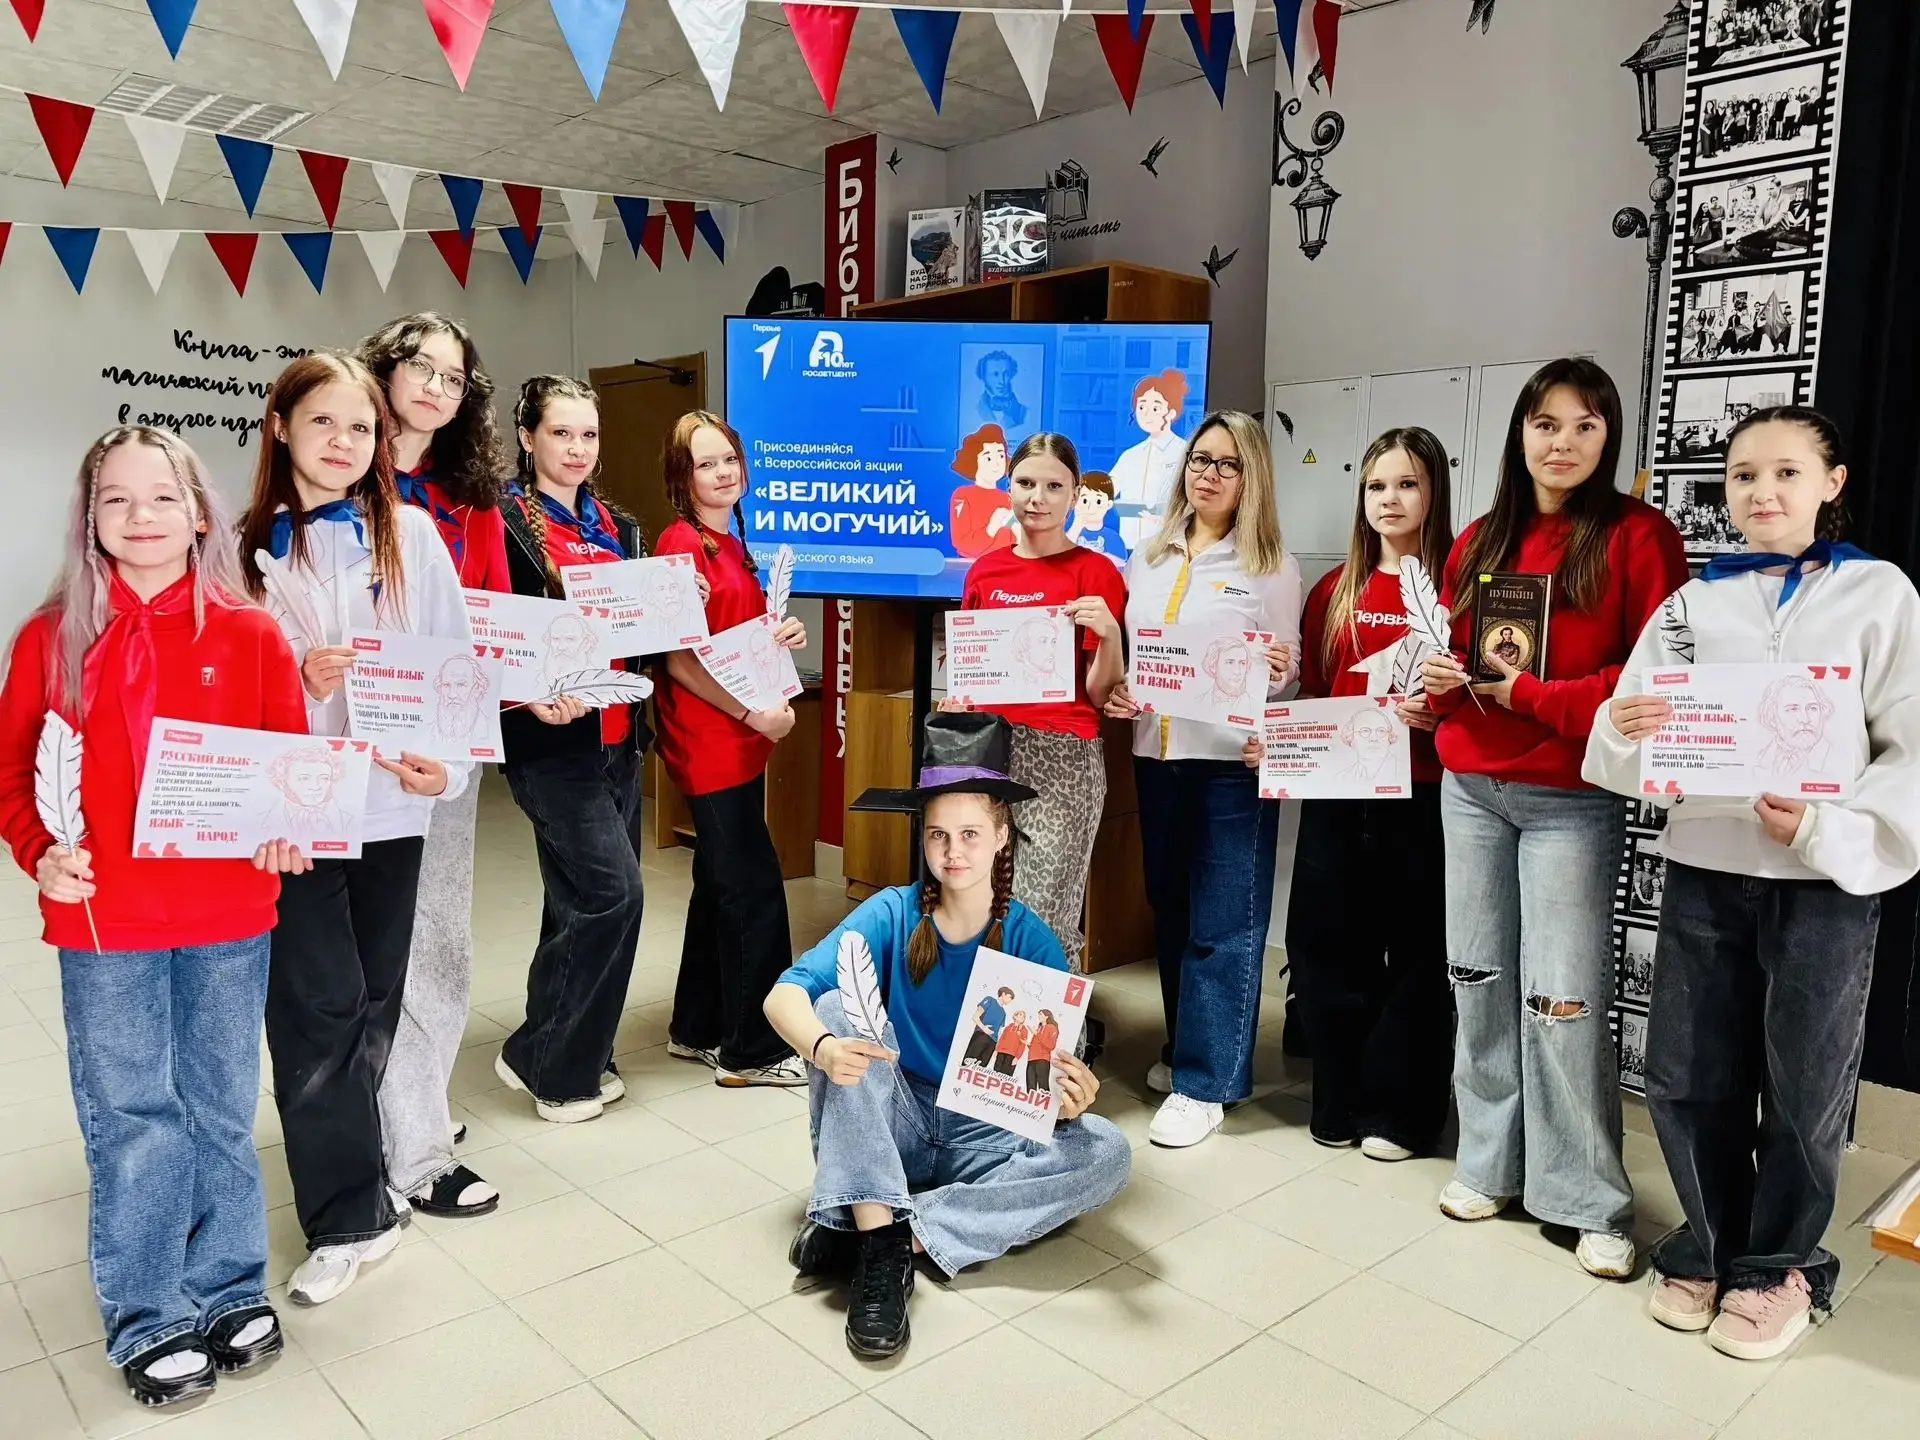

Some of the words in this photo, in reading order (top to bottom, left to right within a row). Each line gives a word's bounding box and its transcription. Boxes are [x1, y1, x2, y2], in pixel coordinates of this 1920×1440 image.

[174, 329, 258, 362] Книга
[102, 366, 244, 396] магический
[754, 440, 853, 454] Присоединяйся
[754, 458, 761, 468] к
[765, 457, 861, 472] Всероссийской
[865, 462, 903, 474] акции
[755, 479, 916, 505] «ВЕЛИКИЙ
[755, 510, 775, 531] И
[783, 510, 944, 536] МОГУЧИЙ»
[565, 542, 598, 558] Пер
[754, 550, 775, 562] Ден
[794, 554, 836, 564] усского
[839, 556, 874, 565] языка
[989, 589, 1045, 604] Первые
[1137, 645, 1164, 653] НАРОД
[1166, 646, 1189, 656] ЖИВ,
[358, 666, 395, 679] РОДНОЙ
[397, 669, 424, 681] ЯЗЫК
[1137, 661, 1195, 677] КУЛЬТУРА
[1136, 675, 1144, 685] И
[1148, 676, 1182, 690] ЯЗЫК
[1673, 711, 1701, 722] СКИЙ
[1704, 713, 1737, 724] ЯЗЫК,
[1653, 734, 1671, 744] ЭТО
[1674, 734, 1736, 746] ДОСТОЯНИЕ,
[160, 750, 215, 765] РУССКИЙ
[216, 755, 251, 766] ЯЗЫК
[1652, 752, 1705, 761] ОБРАЩАЙТЕСЬ
[1652, 761, 1704, 769] ПОЧТИТЕЛЬНО
[149, 818, 184, 828] ЯЗЫК
[196, 831, 239, 843] НАРОД!
[957, 1068, 1052, 1111] ПЕРВЫЙ
